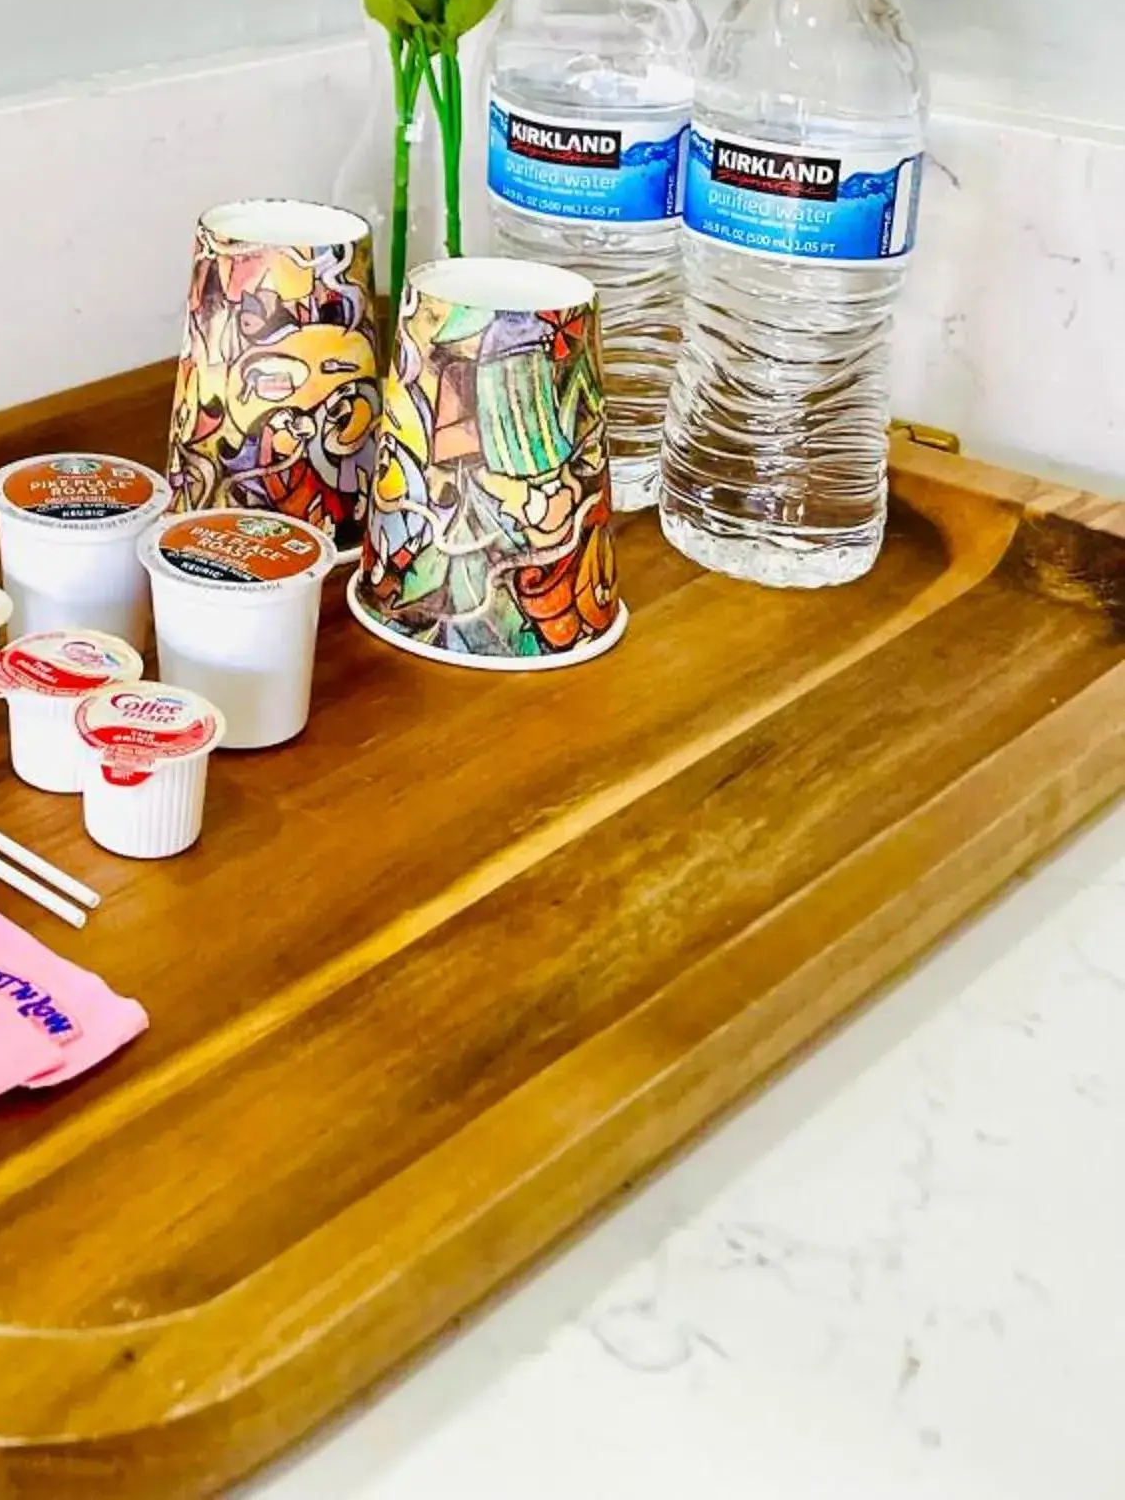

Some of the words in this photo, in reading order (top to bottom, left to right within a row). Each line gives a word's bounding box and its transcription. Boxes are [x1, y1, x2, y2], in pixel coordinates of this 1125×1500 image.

[510, 120, 617, 156] KIRKLAND
[505, 157, 561, 187] purified
[564, 170, 622, 191] water
[717, 147, 835, 186] KIRKLAND
[708, 186, 771, 217] purified
[776, 203, 835, 226] water
[794, 237, 820, 253] 1.05
[28, 478, 69, 491] PIKE
[50, 486, 109, 498] ROAST
[62, 509, 107, 518] KEURIG
[196, 538, 254, 561] ROAST
[179, 561, 224, 580] KEURIG
[110, 693, 185, 717] Coffee
